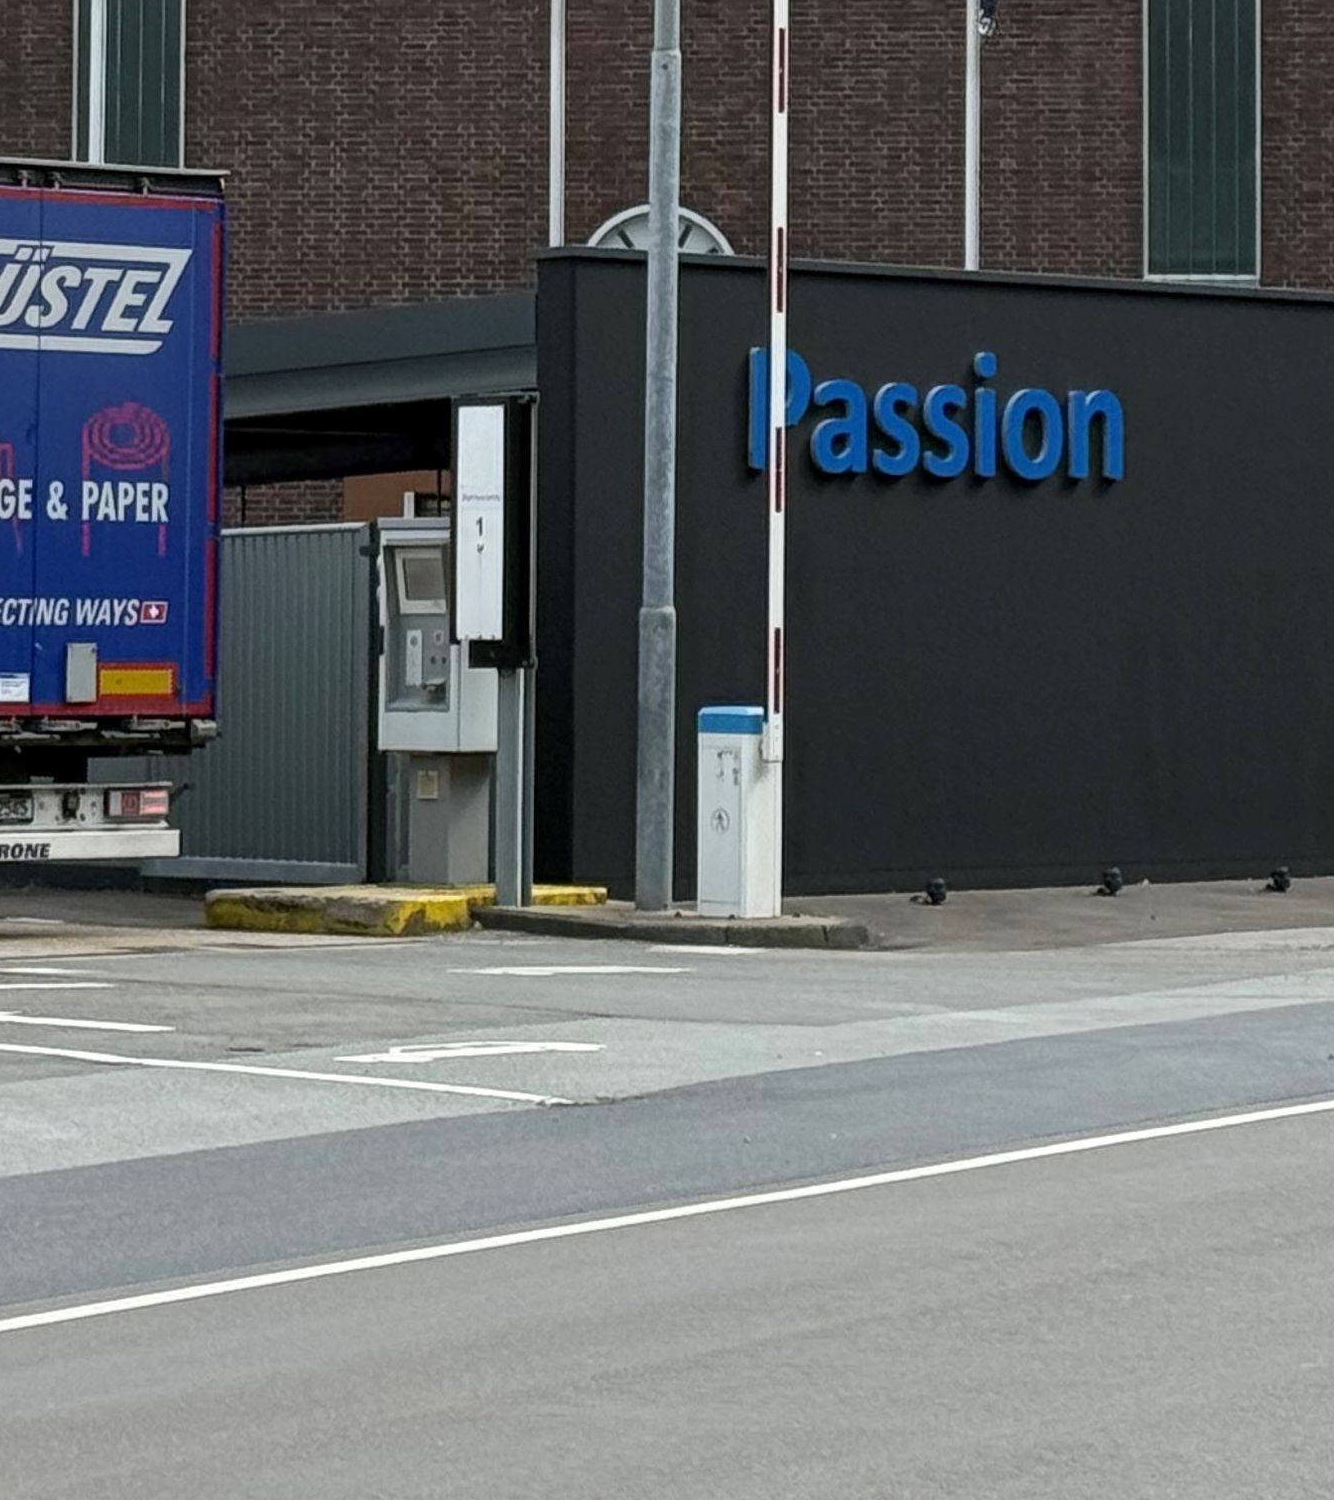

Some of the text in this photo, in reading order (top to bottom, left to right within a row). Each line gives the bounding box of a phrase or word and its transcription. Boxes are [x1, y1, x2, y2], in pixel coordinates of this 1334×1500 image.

[748, 346, 1124, 481] Passion
[47, 481, 67, 520] &
[82, 481, 169, 523] PAPER
[76, 598, 139, 626] WAYS
